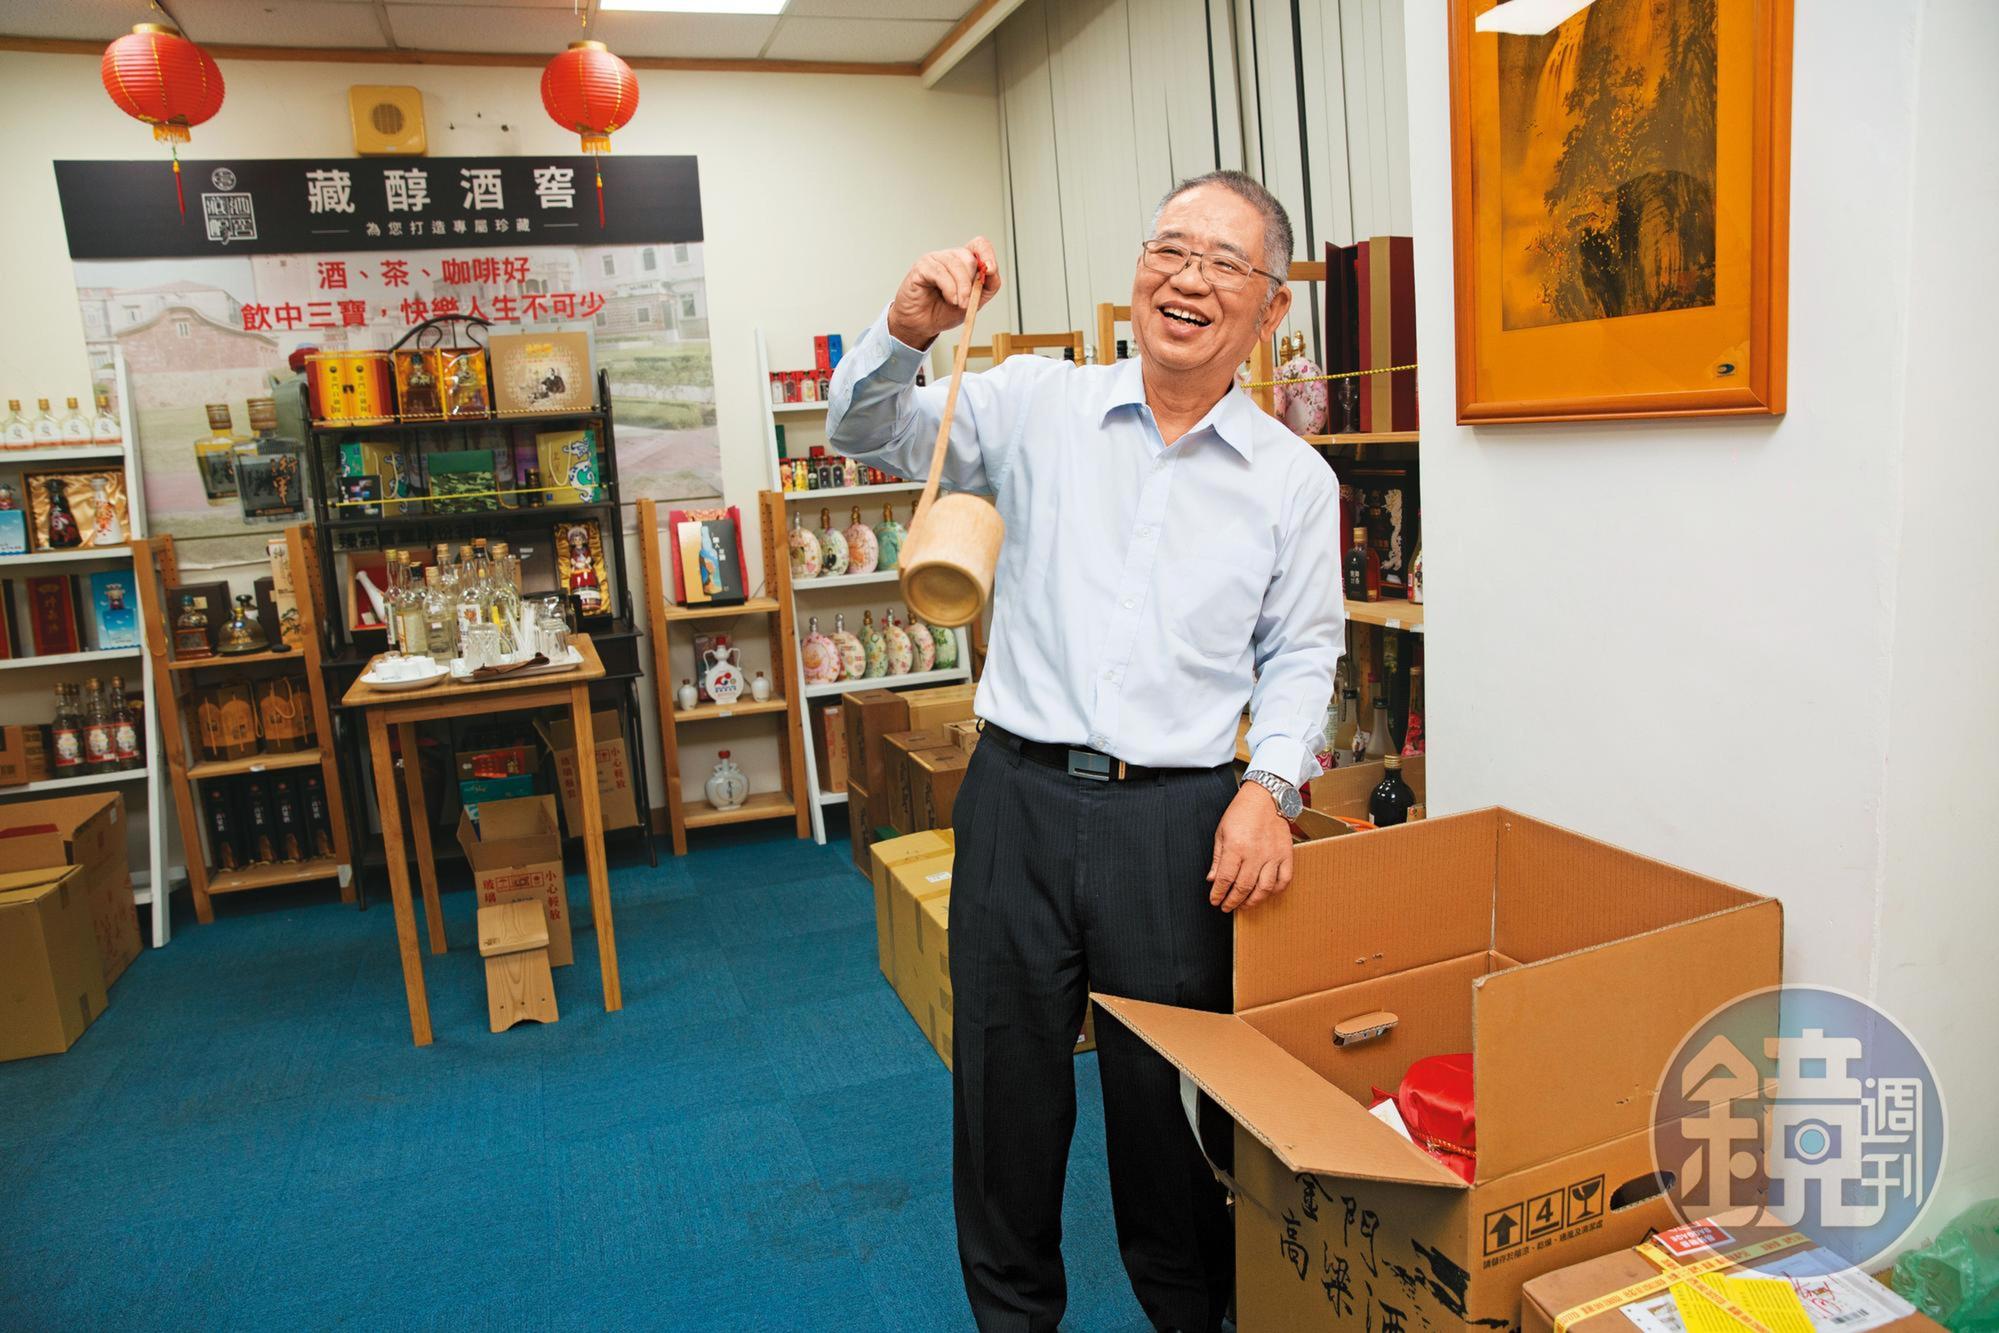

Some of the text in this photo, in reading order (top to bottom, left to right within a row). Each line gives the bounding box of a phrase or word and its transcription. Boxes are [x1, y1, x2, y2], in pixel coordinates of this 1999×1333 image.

[305, 167, 577, 215] 藏醇酒窖
[366, 217, 531, 238] 為您打造專屬珍藏
[318, 256, 531, 291] 酒、茶、咖啡好
[1535, 1197, 1554, 1223] 4
